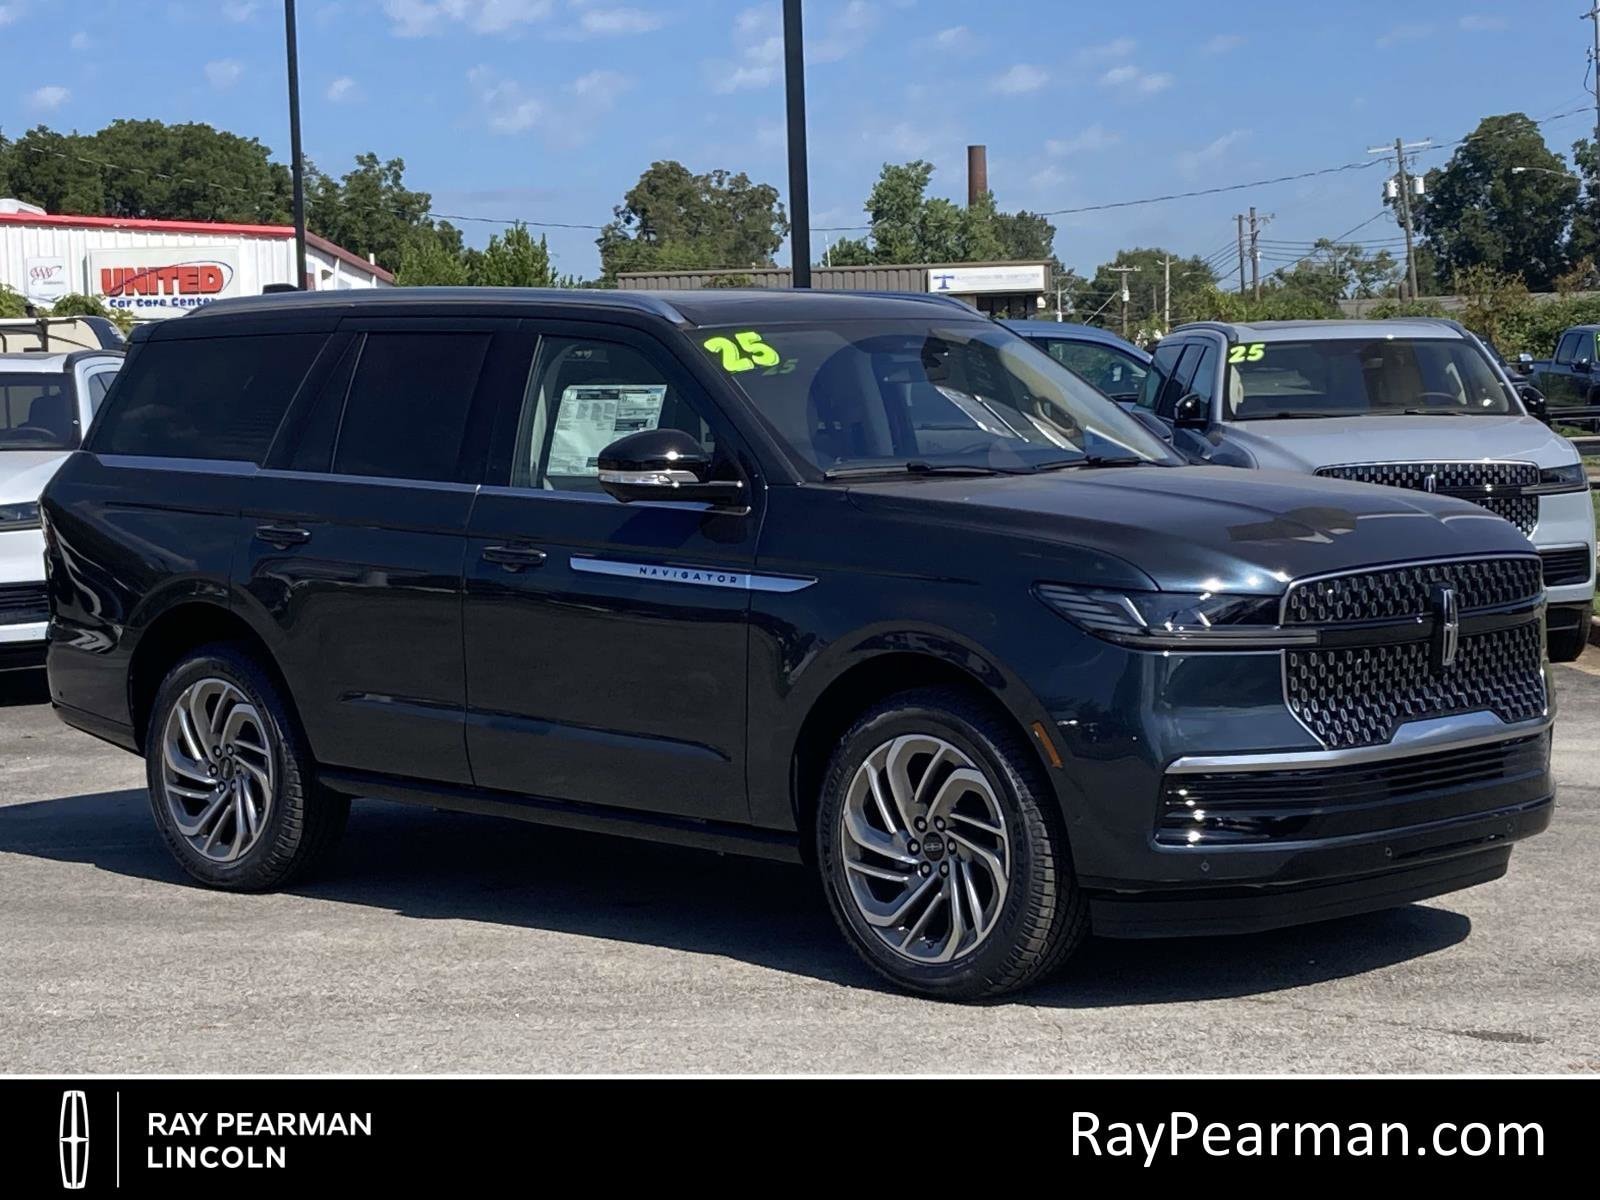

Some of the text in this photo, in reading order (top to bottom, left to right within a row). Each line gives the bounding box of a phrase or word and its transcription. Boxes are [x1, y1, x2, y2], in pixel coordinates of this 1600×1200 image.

[100, 266, 225, 297] UNITED
[109, 299, 132, 309] Car
[137, 298, 167, 308] Care
[703, 331, 780, 373] 25
[1228, 343, 1266, 363] 25
[638, 566, 737, 584] NAVIGATOR
